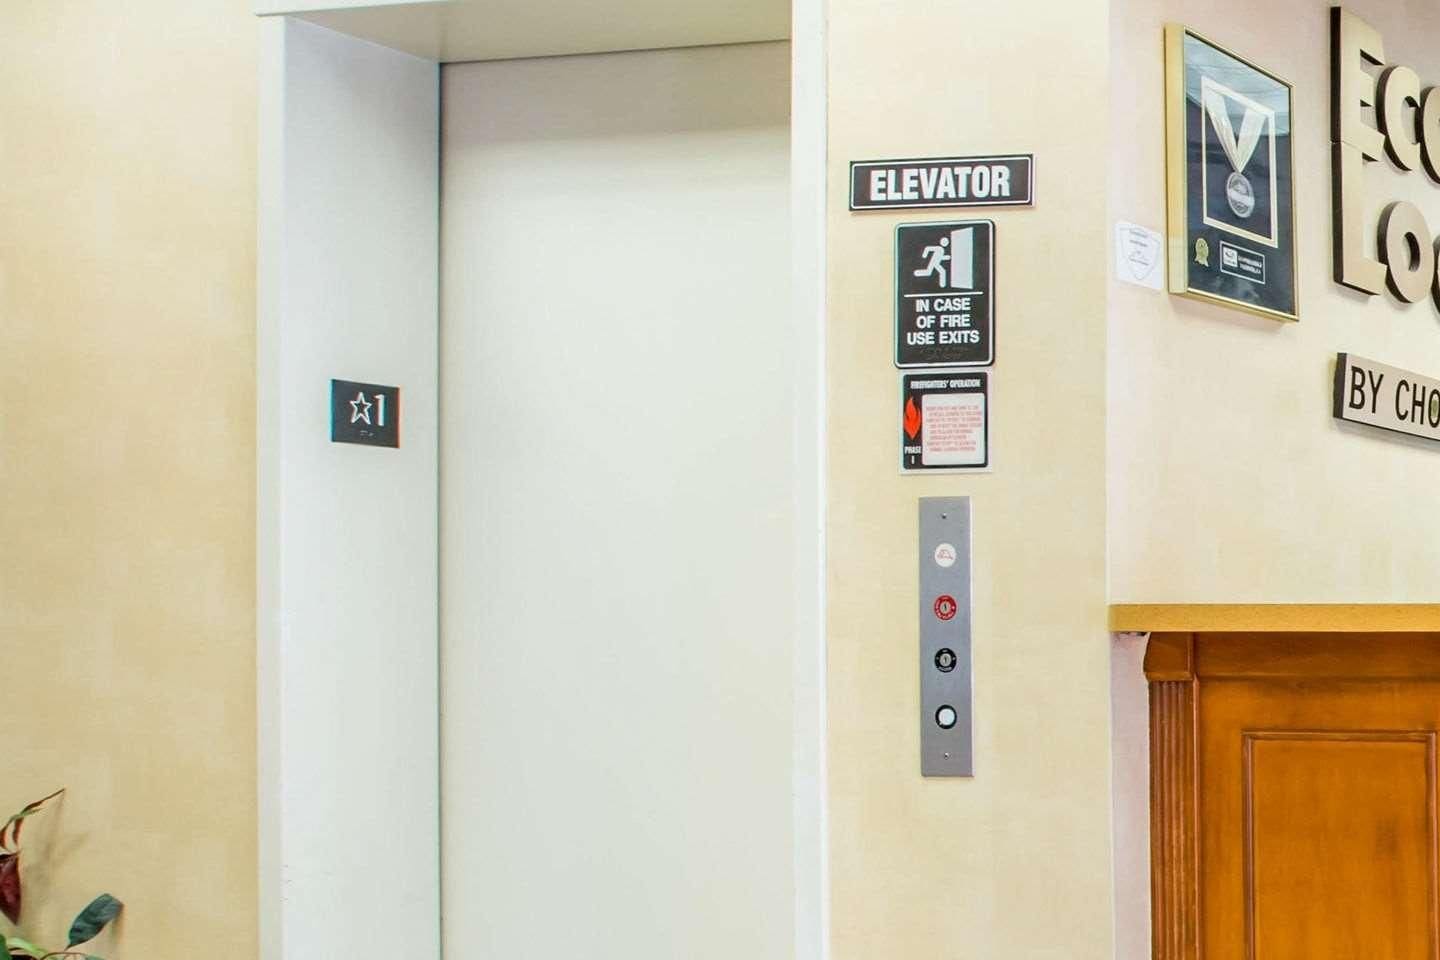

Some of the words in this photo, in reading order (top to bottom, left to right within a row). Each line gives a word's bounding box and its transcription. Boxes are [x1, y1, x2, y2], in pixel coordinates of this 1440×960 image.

[870, 165, 1011, 201] ELEVATOR
[915, 299, 930, 312] IN
[933, 298, 971, 312] CASE
[916, 315, 936, 329] OF
[940, 314, 971, 328] FIRE
[907, 332, 935, 345] USE
[939, 330, 980, 344] EXITS
[1348, 365, 1384, 414] BY
[374, 393, 385, 427] 1
